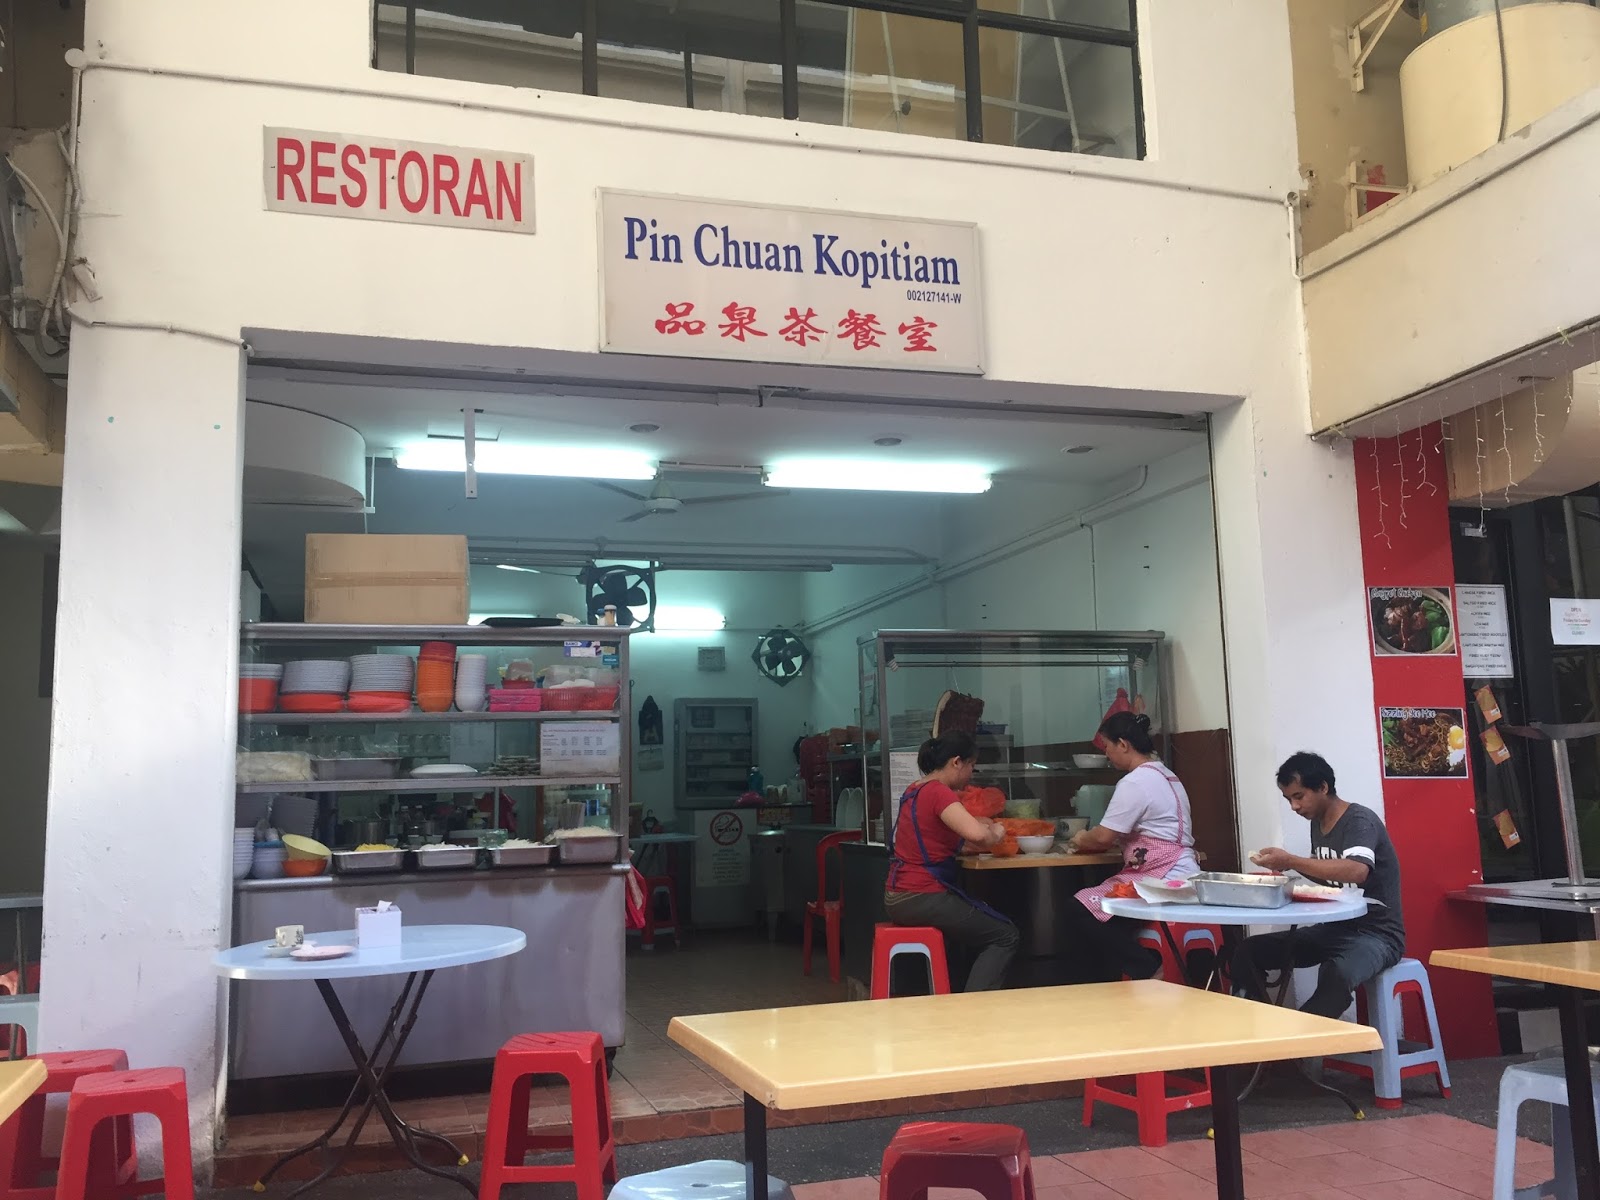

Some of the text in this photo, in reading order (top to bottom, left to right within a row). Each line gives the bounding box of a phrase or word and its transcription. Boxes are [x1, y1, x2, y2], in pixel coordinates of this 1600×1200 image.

[276, 137, 522, 223] RESTORAN
[624, 217, 960, 288] Pin Chuan Kopitiam
[655, 301, 938, 352] 品泉茶餐室
[906, 289, 962, 304] 002127141-W
